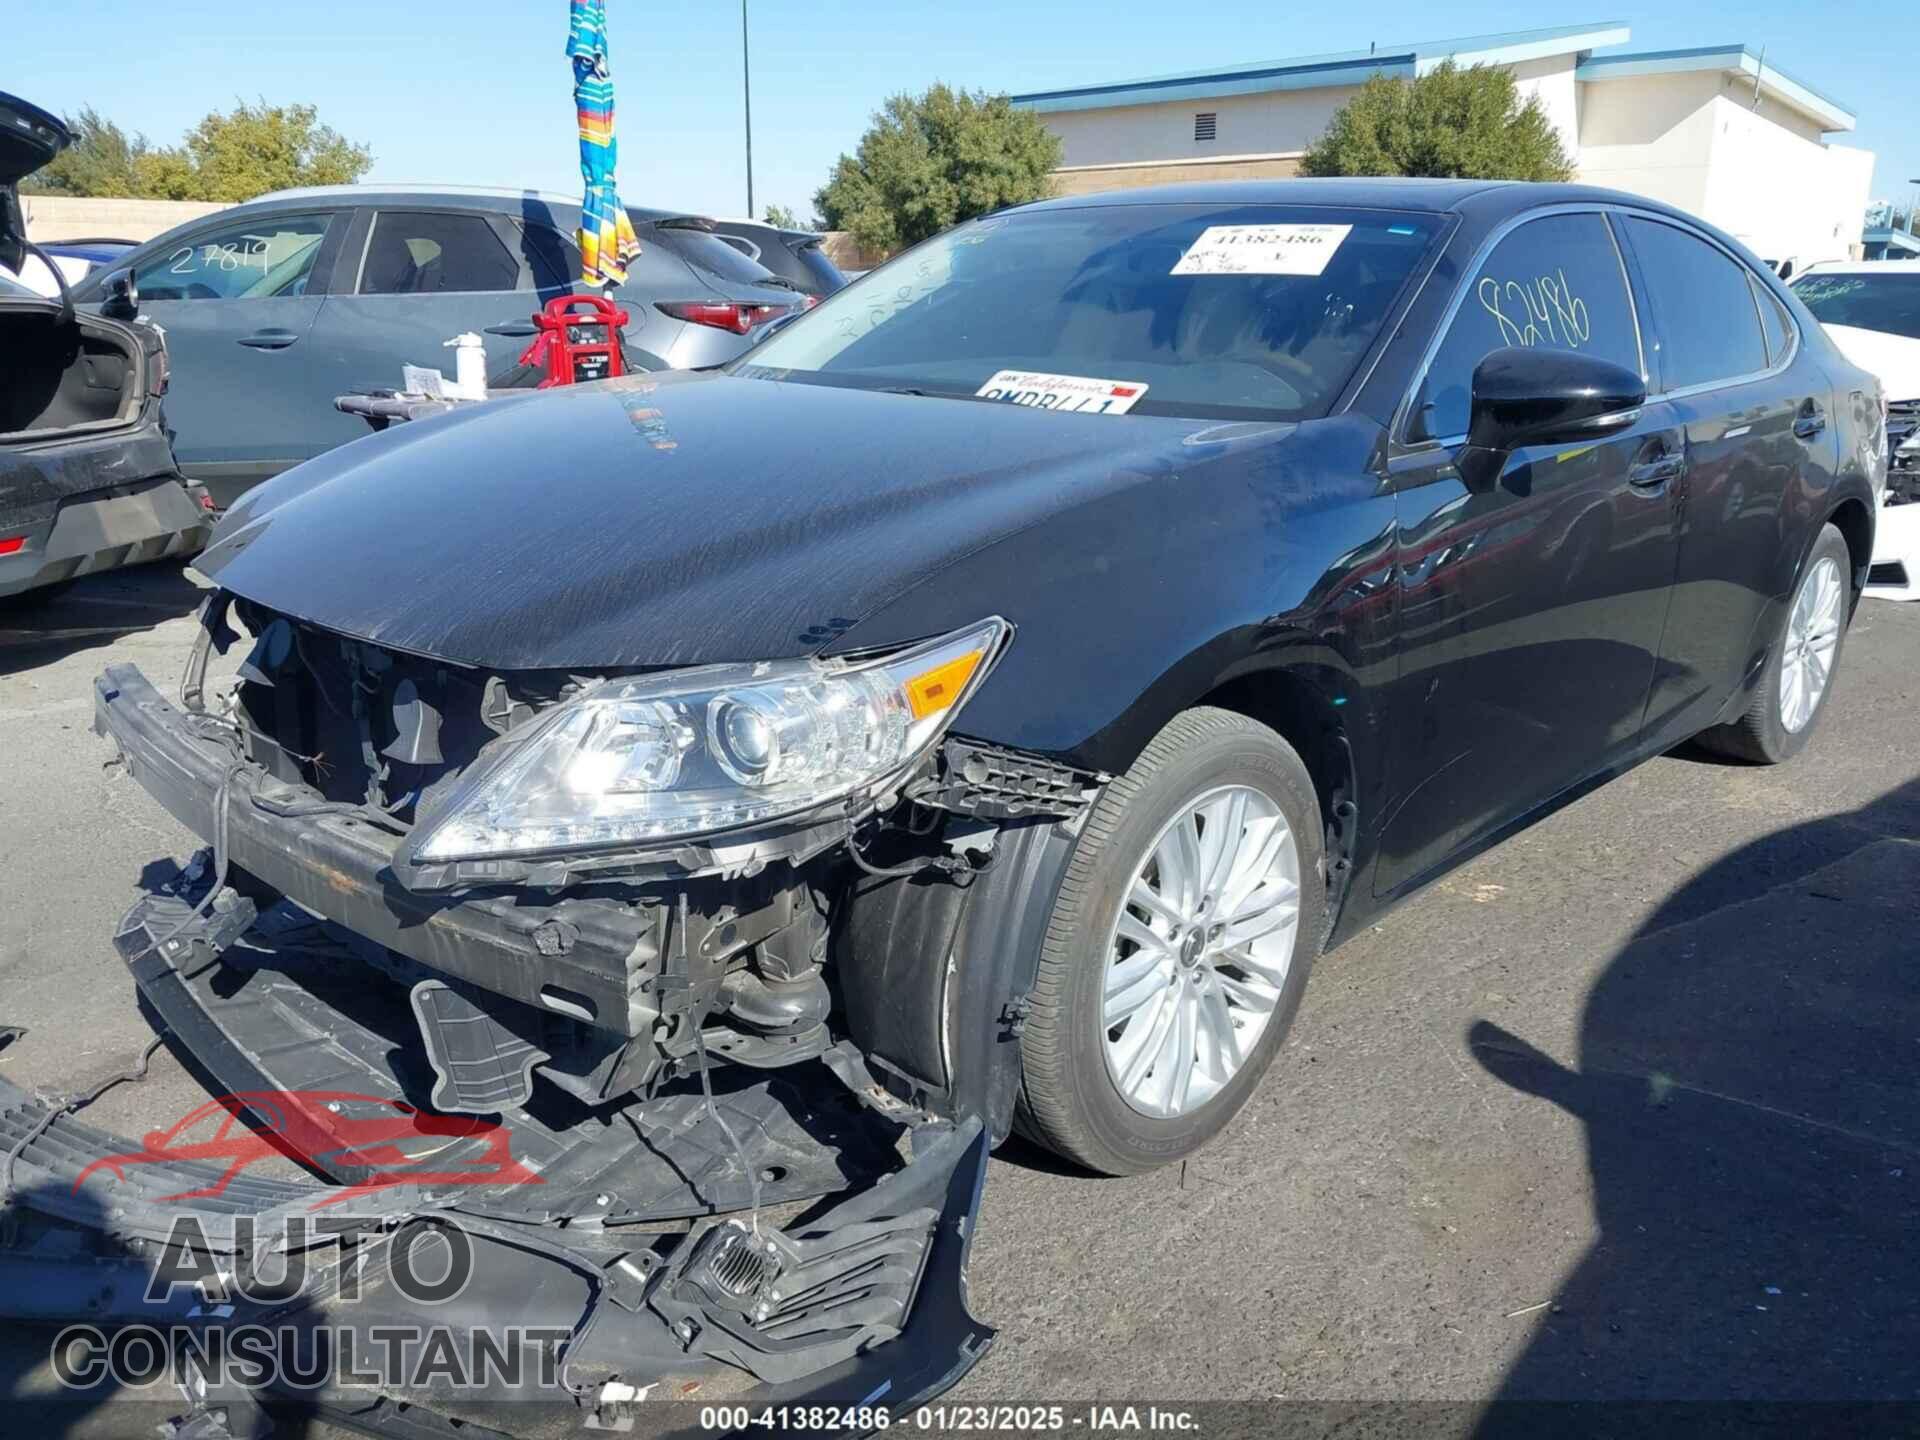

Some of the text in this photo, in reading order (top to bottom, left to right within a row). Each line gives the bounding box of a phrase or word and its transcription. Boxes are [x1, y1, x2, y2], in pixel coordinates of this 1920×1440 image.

[168, 239, 272, 277] 27819
[1478, 266, 1590, 348] 82486
[1017, 374, 1106, 395] California
